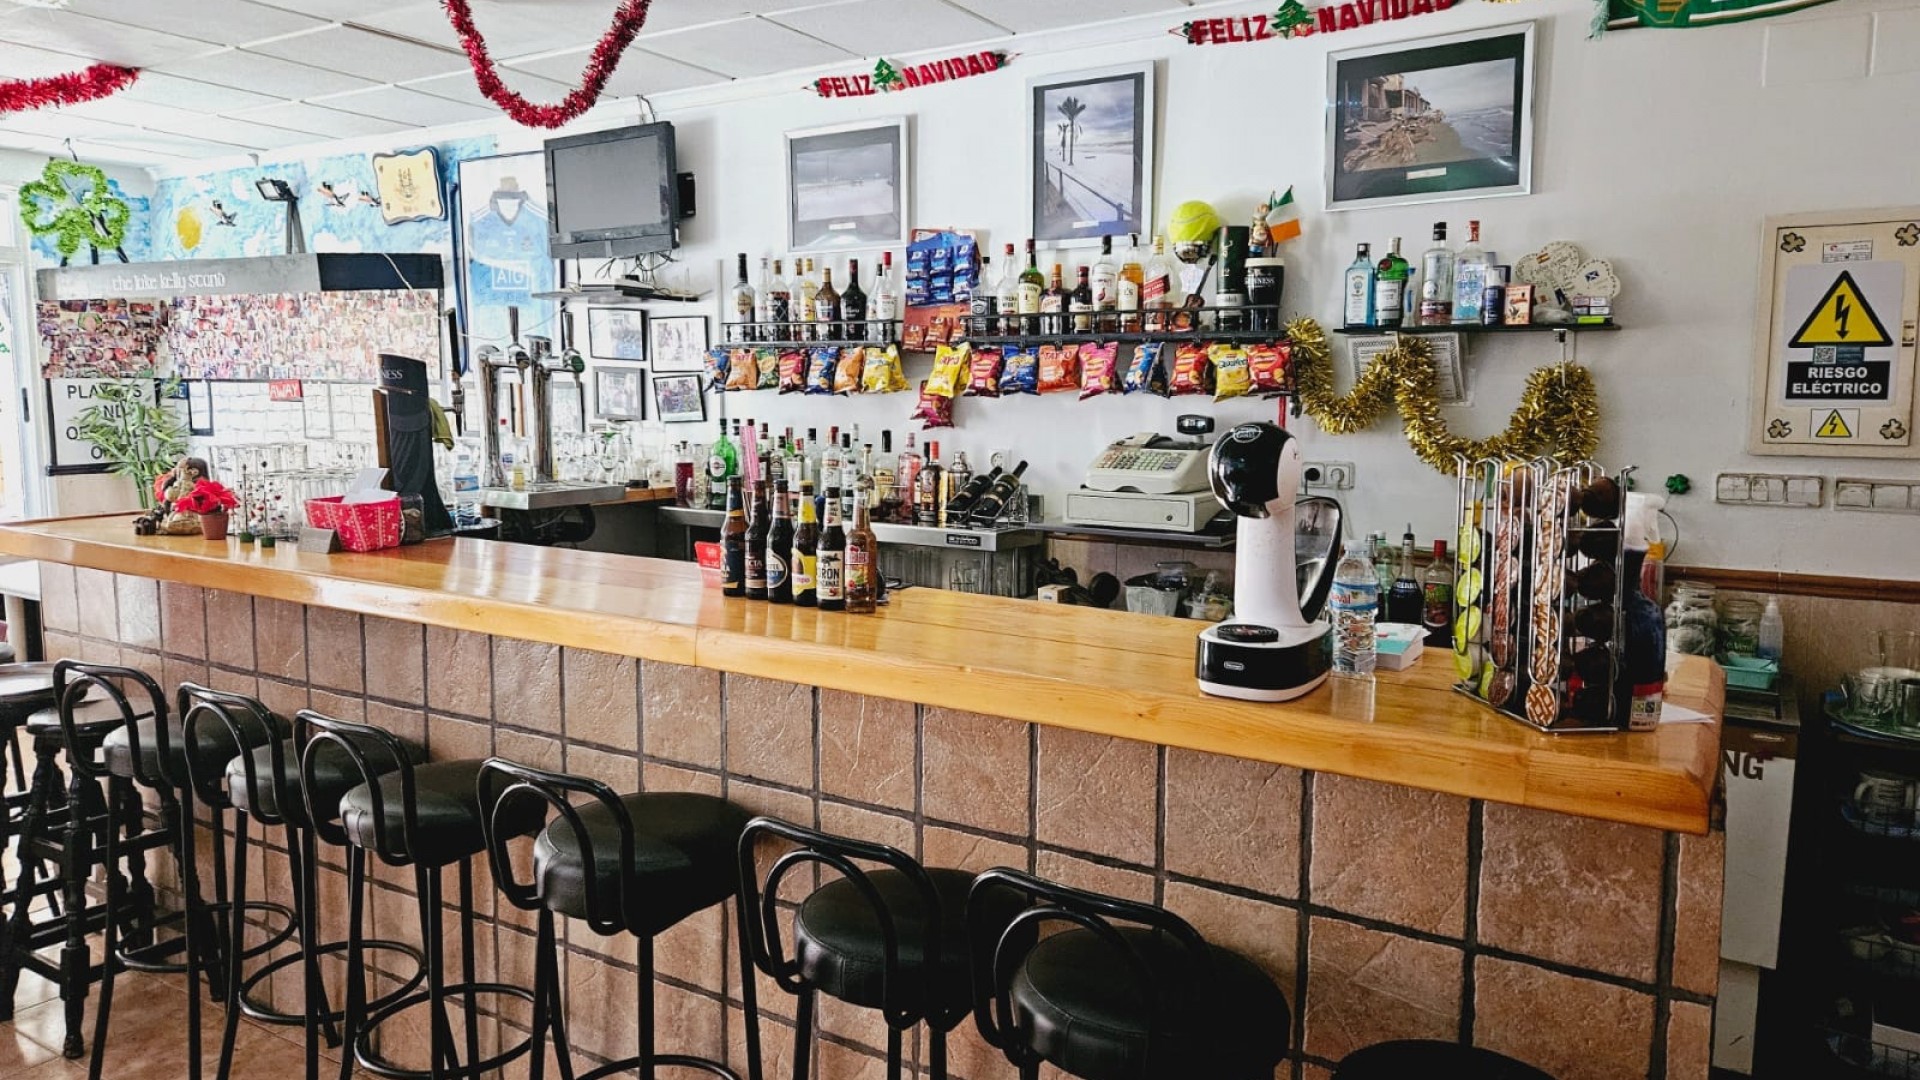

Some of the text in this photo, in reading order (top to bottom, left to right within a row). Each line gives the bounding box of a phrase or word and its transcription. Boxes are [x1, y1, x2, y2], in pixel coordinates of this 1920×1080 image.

[1192, 15, 1269, 46] FELIZ
[818, 50, 998, 98] FELIZ NAVIDAD
[1807, 366, 1868, 379] RIESGO
[270, 383, 297, 399] AWAY
[1792, 379, 1882, 395] ELÉCTRICO
